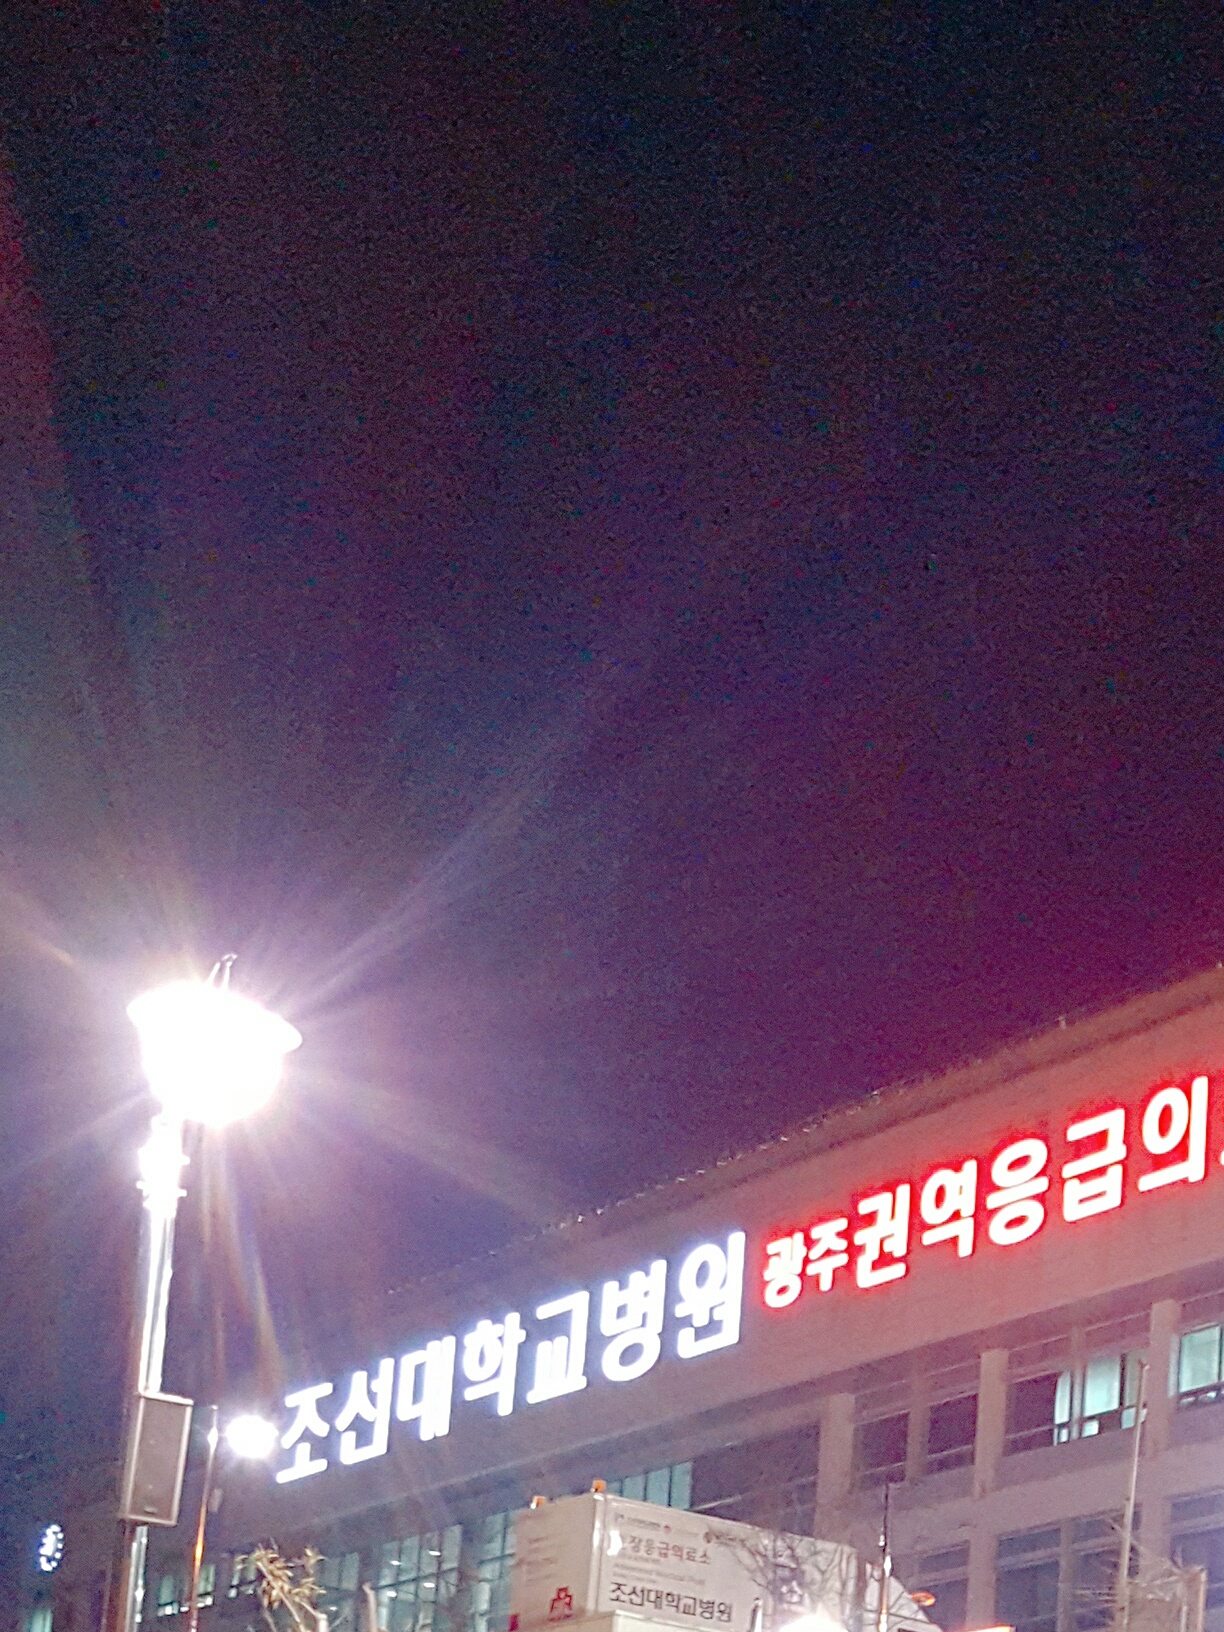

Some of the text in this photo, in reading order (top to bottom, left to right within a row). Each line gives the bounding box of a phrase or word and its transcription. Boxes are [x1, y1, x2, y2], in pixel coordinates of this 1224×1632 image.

[275, 1231, 746, 1484] 조선대학교병원
[616, 1533, 711, 1565] 장응급의료소
[610, 1581, 733, 1624] 조선대학교병원
